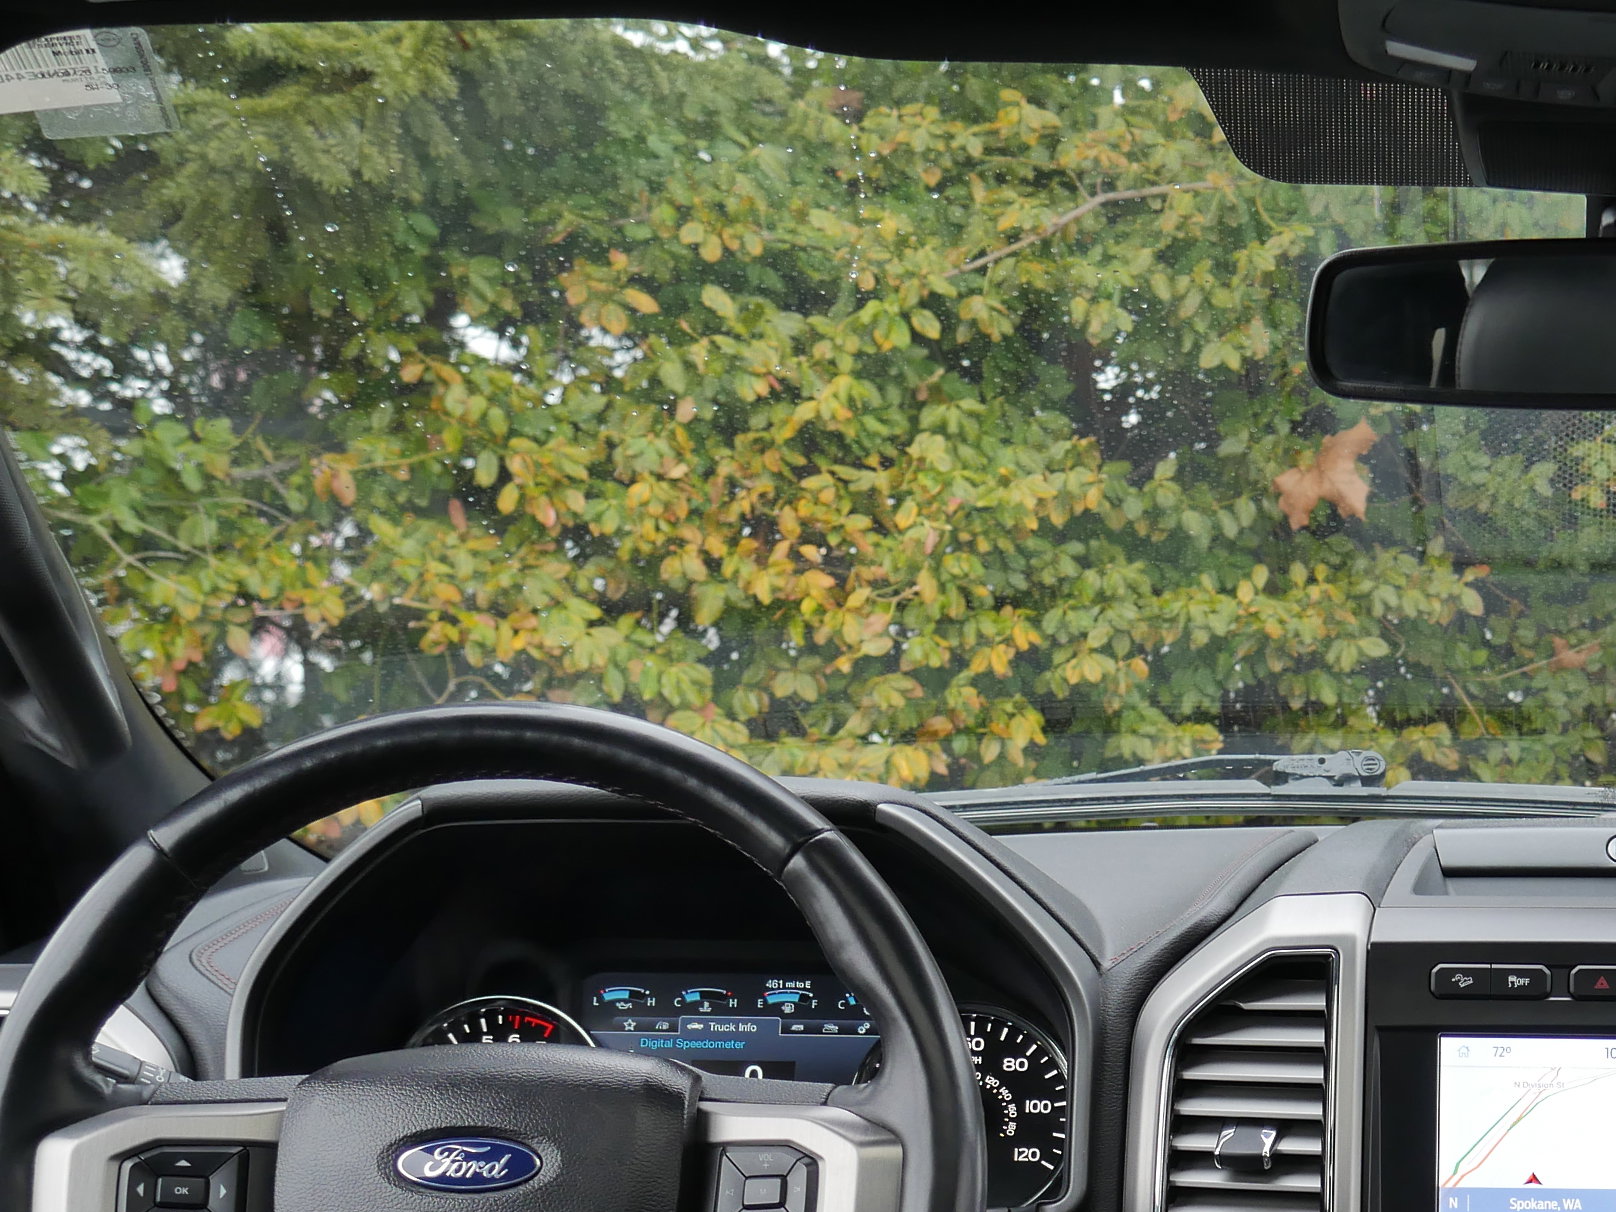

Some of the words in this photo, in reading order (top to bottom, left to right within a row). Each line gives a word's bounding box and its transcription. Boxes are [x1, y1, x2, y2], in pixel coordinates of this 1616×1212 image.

[766, 980, 783, 989] 461
[786, 980, 795, 989] mi
[796, 981, 805, 989] to
[805, 981, 812, 989] E
[1517, 978, 1530, 986] OFF
[593, 997, 600, 1006] L
[647, 998, 656, 1007] H
[674, 998, 682, 1008] C
[729, 999, 738, 1008] H
[757, 999, 764, 1008] E
[812, 1000, 818, 1009] F
[838, 1000, 846, 1010] C
[709, 1022, 736, 1032] Truck
[739, 1022, 757, 1033] Info
[640, 1038, 674, 1051] Digital
[676, 1039, 746, 1051] Speedometer
[1003, 1058, 1029, 1072] 80
[985, 1075, 1000, 1087] 120
[999, 1087, 1012, 1101] 140
[1025, 1100, 1052, 1114] 100
[1014, 1148, 1041, 1162] 120
[424, 1145, 512, 1179] Ford
[174, 1186, 189, 1195] OK
[1449, 1197, 1458, 1209] N
[1509, 1198, 1561, 1212] Spokane,
[1563, 1199, 1583, 1211] WA
